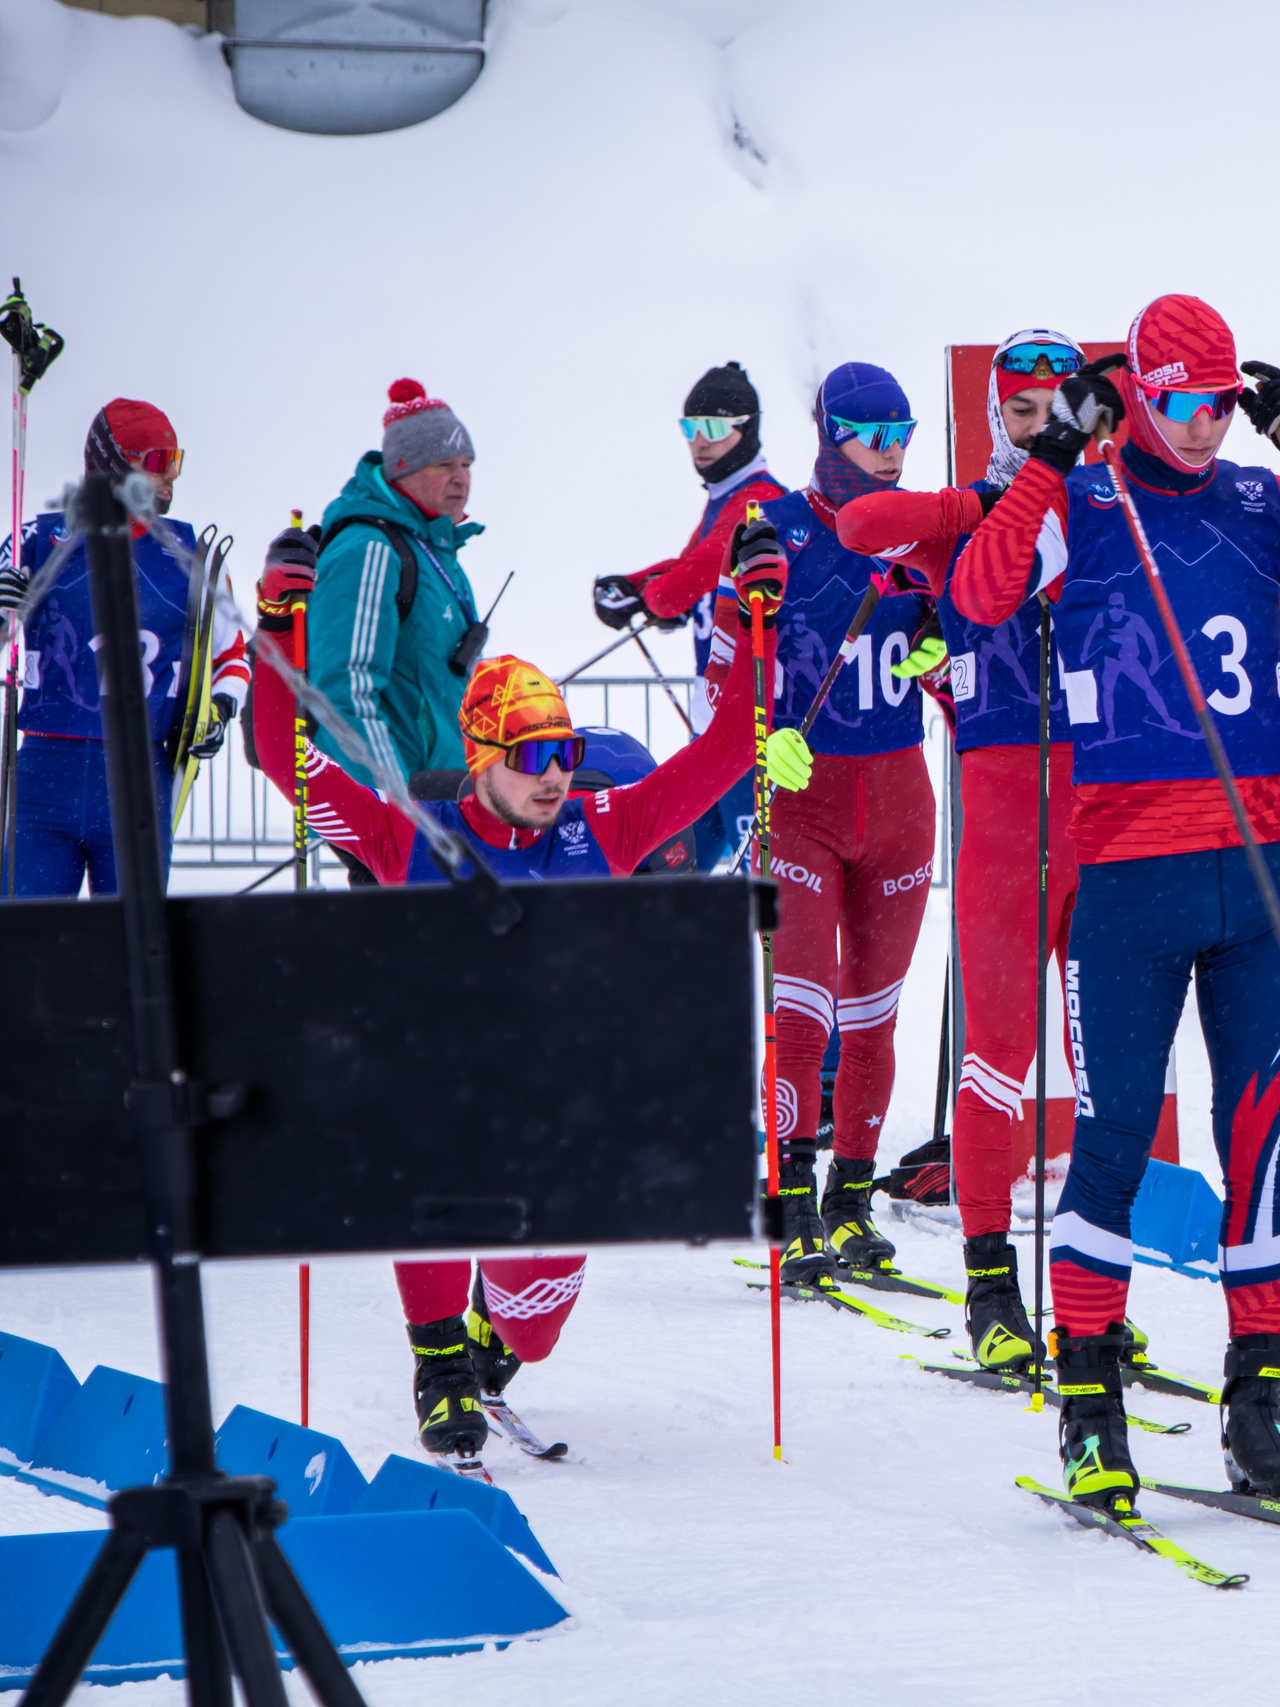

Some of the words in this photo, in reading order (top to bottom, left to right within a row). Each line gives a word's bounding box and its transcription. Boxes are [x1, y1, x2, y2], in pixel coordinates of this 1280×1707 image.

[844, 631, 911, 710] 10
[1200, 614, 1251, 716] 3
[517, 721, 569, 737] FISCHER
[754, 705, 767, 767] LEKI
[294, 717, 307, 779] LEKI
[778, 1187, 811, 1196] CHER
[843, 1181, 872, 1190] FISC
[852, 1271, 873, 1281] FISCHER
[1001, 1376, 1020, 1388] FISCHER
